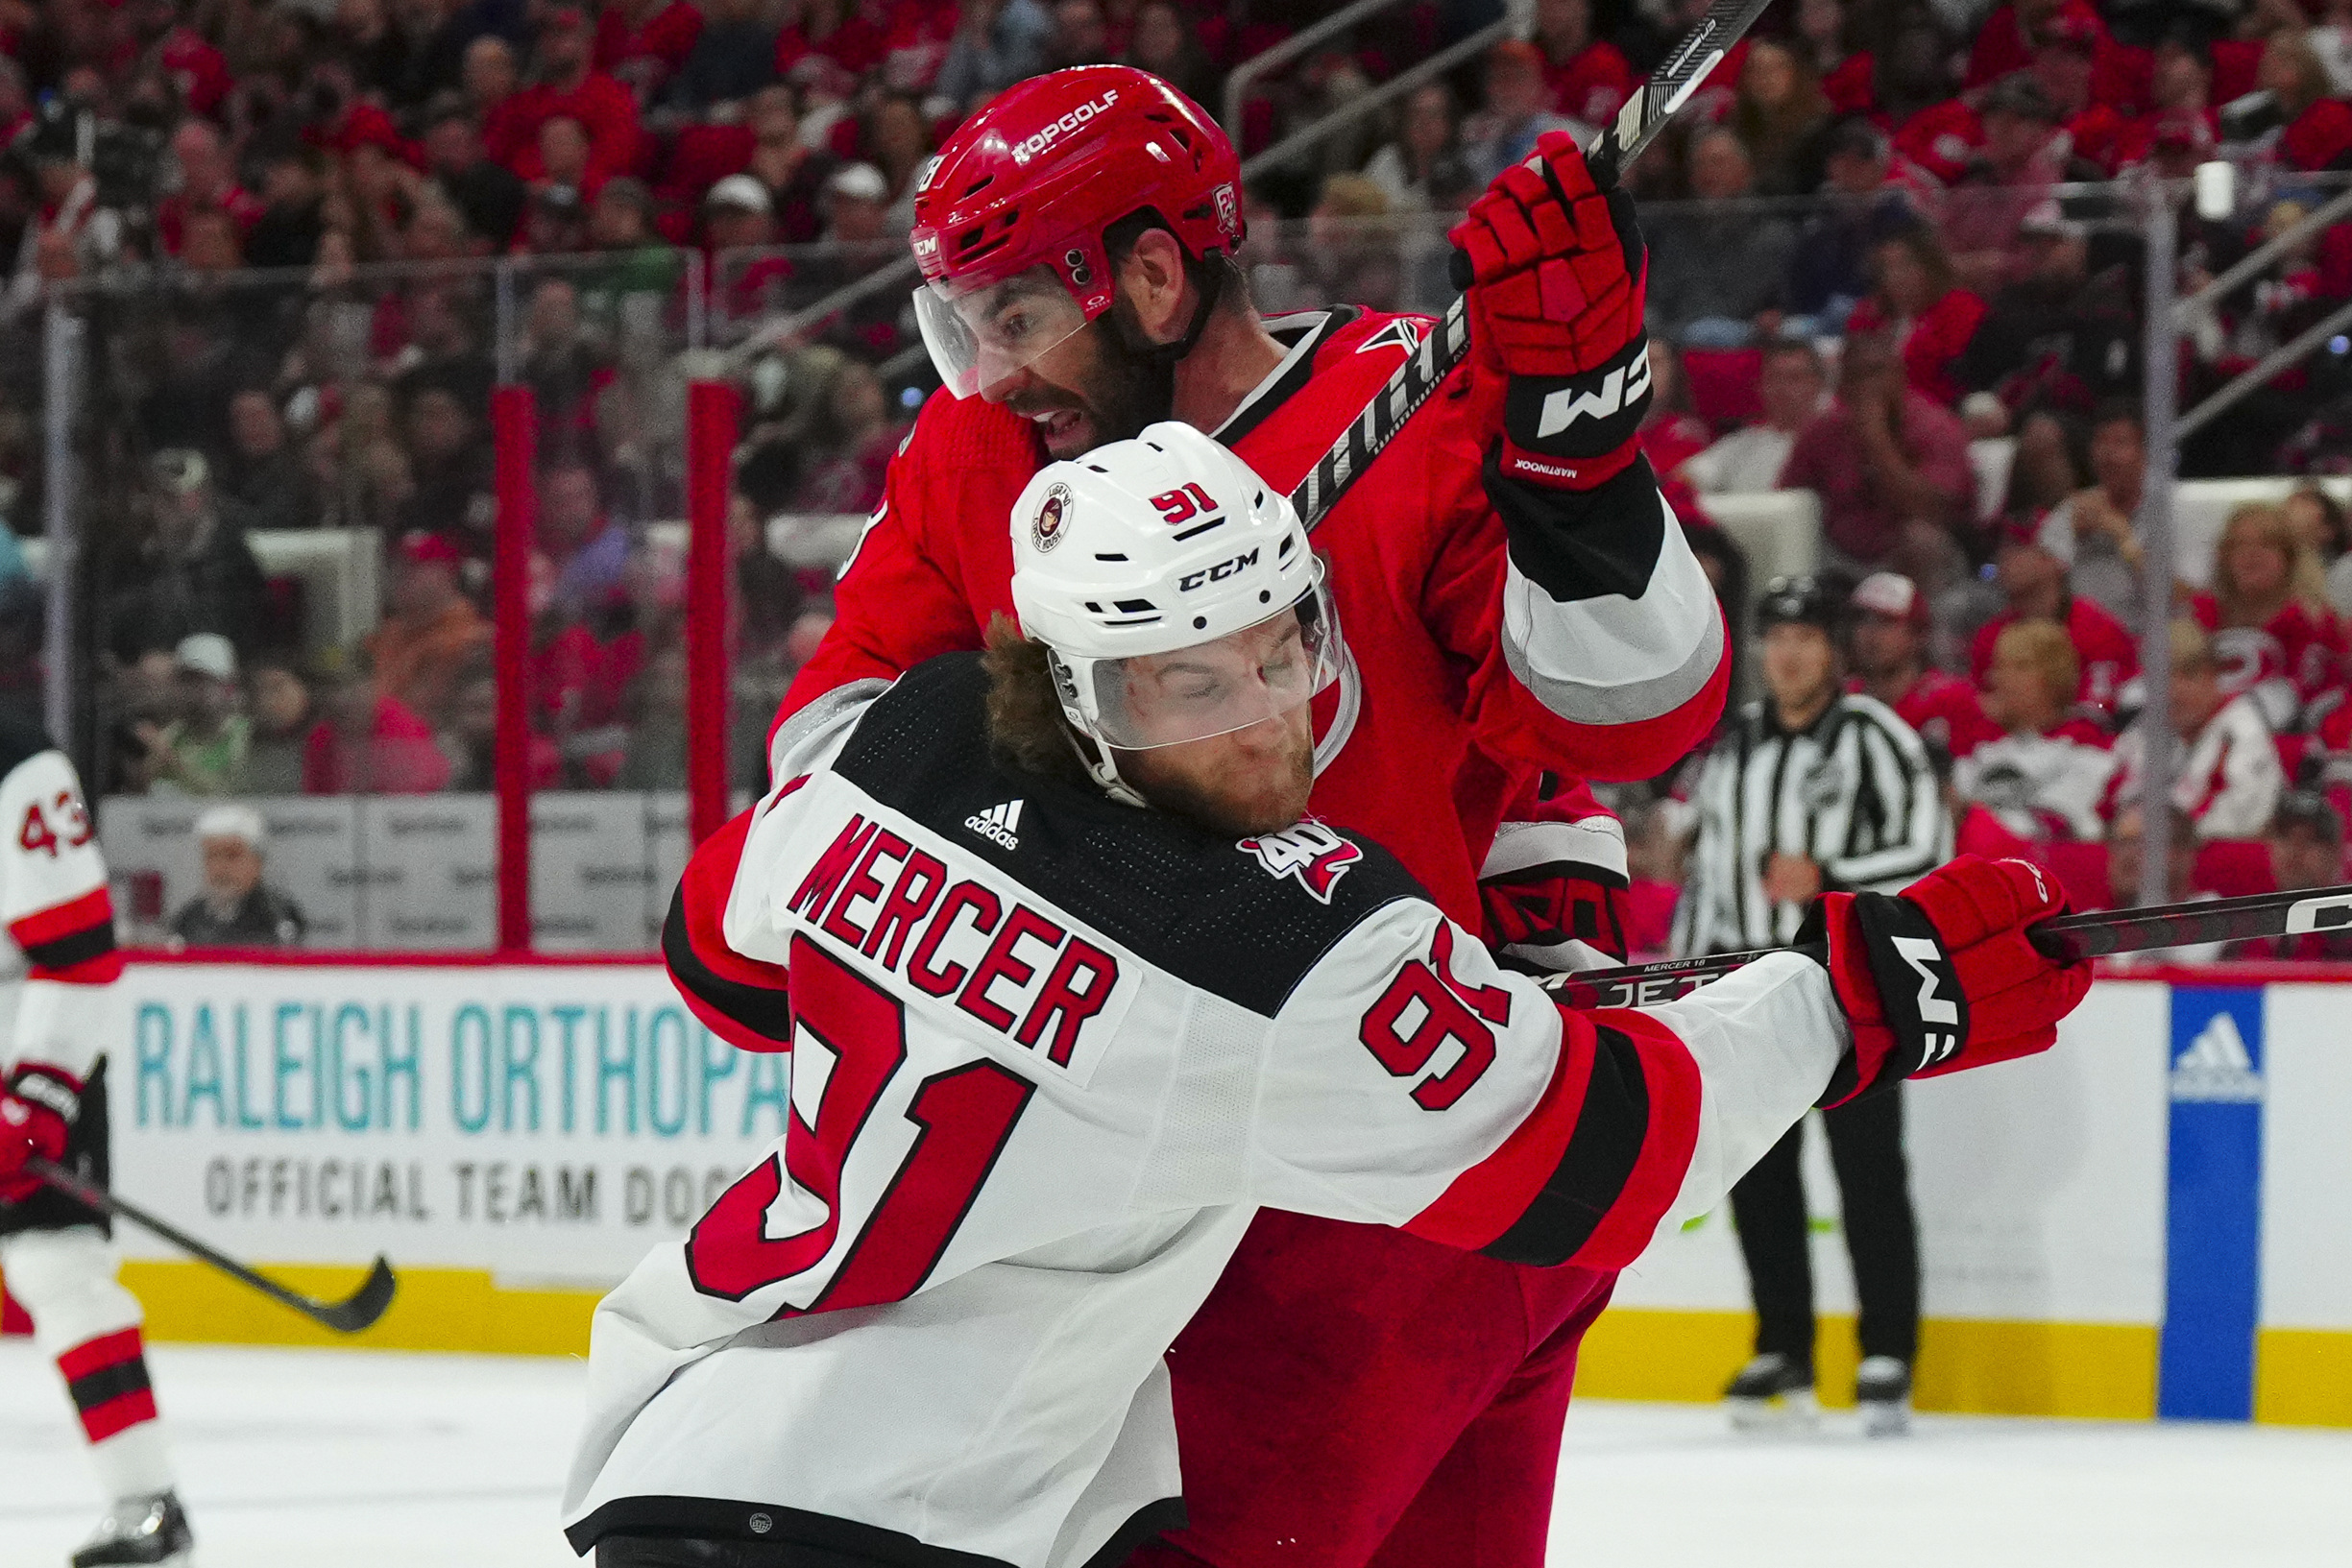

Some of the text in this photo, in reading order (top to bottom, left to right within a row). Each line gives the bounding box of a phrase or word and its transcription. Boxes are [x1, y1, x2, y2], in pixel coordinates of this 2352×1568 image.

[1011, 89, 1119, 163] TOPGOLF
[1515, 458, 1578, 479] MARTINOOK
[1149, 482, 1219, 526] 91
[1042, 529, 1062, 550] HOUSE
[1179, 547, 1260, 592] CCM
[19, 791, 94, 857] 43
[964, 814, 1019, 851] adidas
[787, 812, 1120, 1070] MERCER
[1644, 960, 1690, 973] MERCER
[1359, 915, 1513, 1112] 91
[134, 1001, 788, 1138] RALEIGH ORTHOPA
[685, 929, 1039, 1323] 91
[206, 1157, 430, 1221] OFFICIAL
[453, 1160, 603, 1226] TEAM
